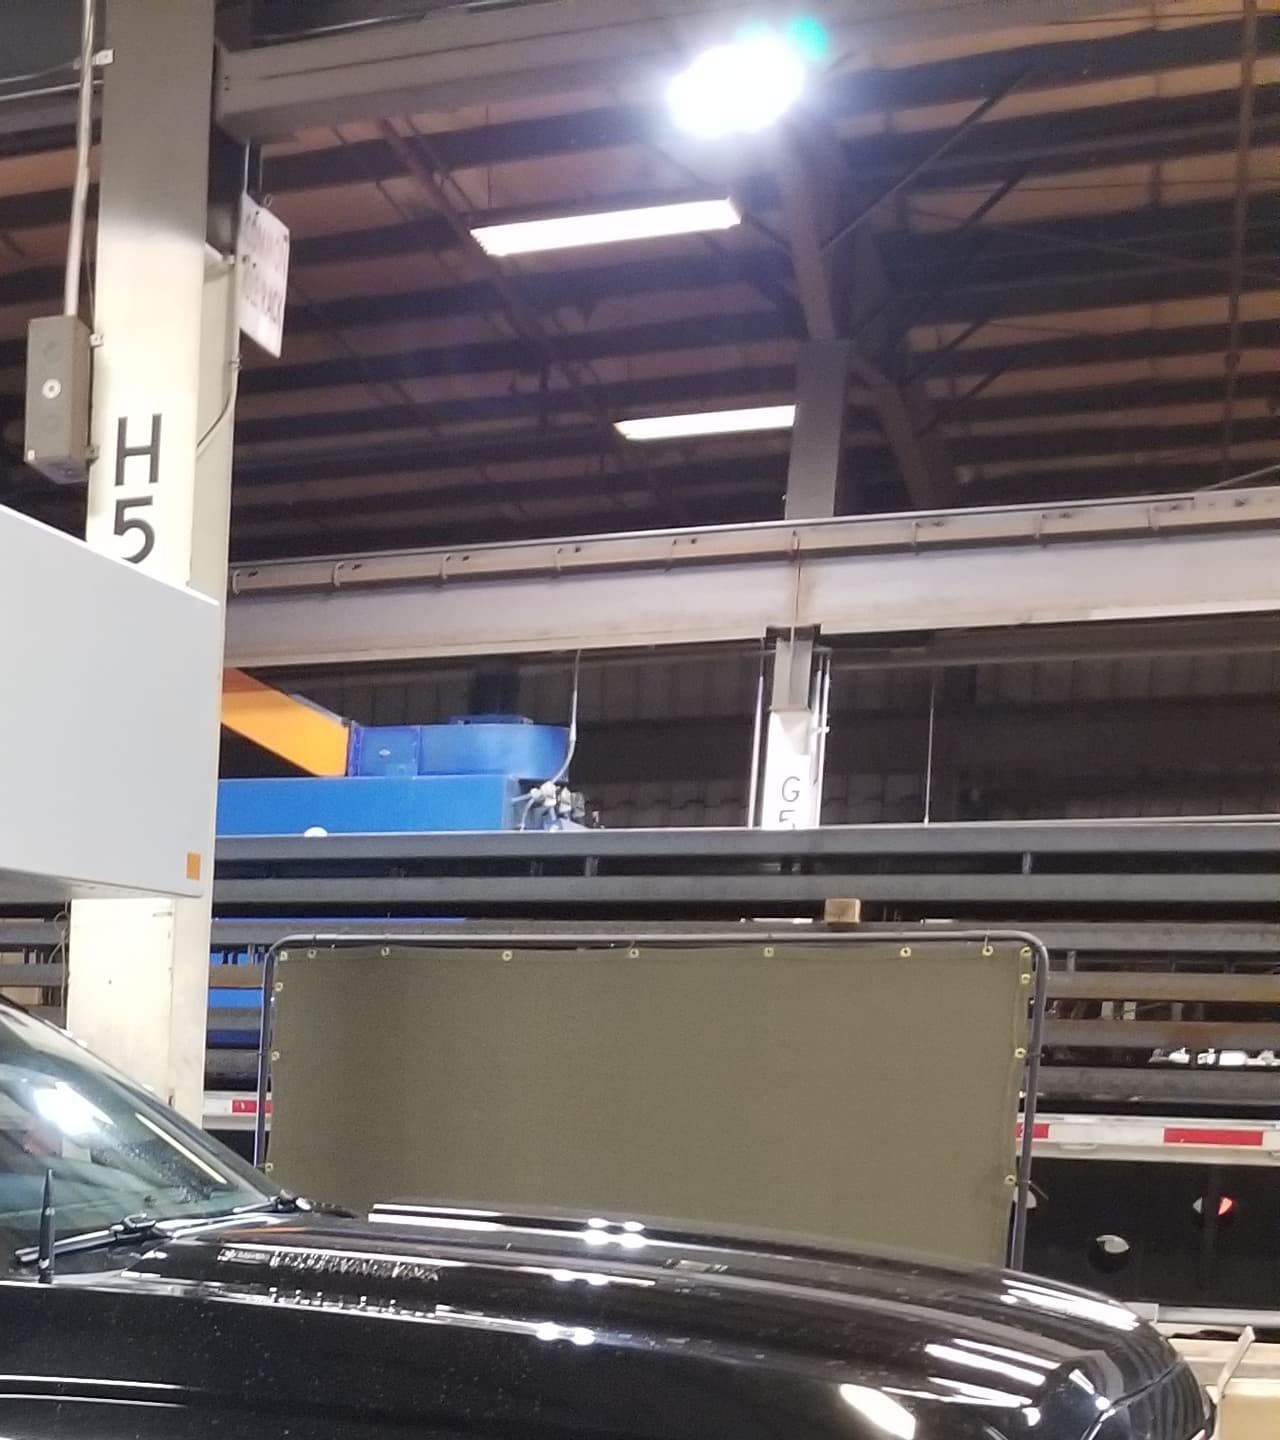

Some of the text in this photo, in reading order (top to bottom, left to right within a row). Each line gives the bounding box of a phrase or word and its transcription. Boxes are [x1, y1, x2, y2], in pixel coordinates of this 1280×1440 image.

[114, 412, 162, 487] H
[113, 495, 156, 565] 5
[781, 775, 801, 803] G
